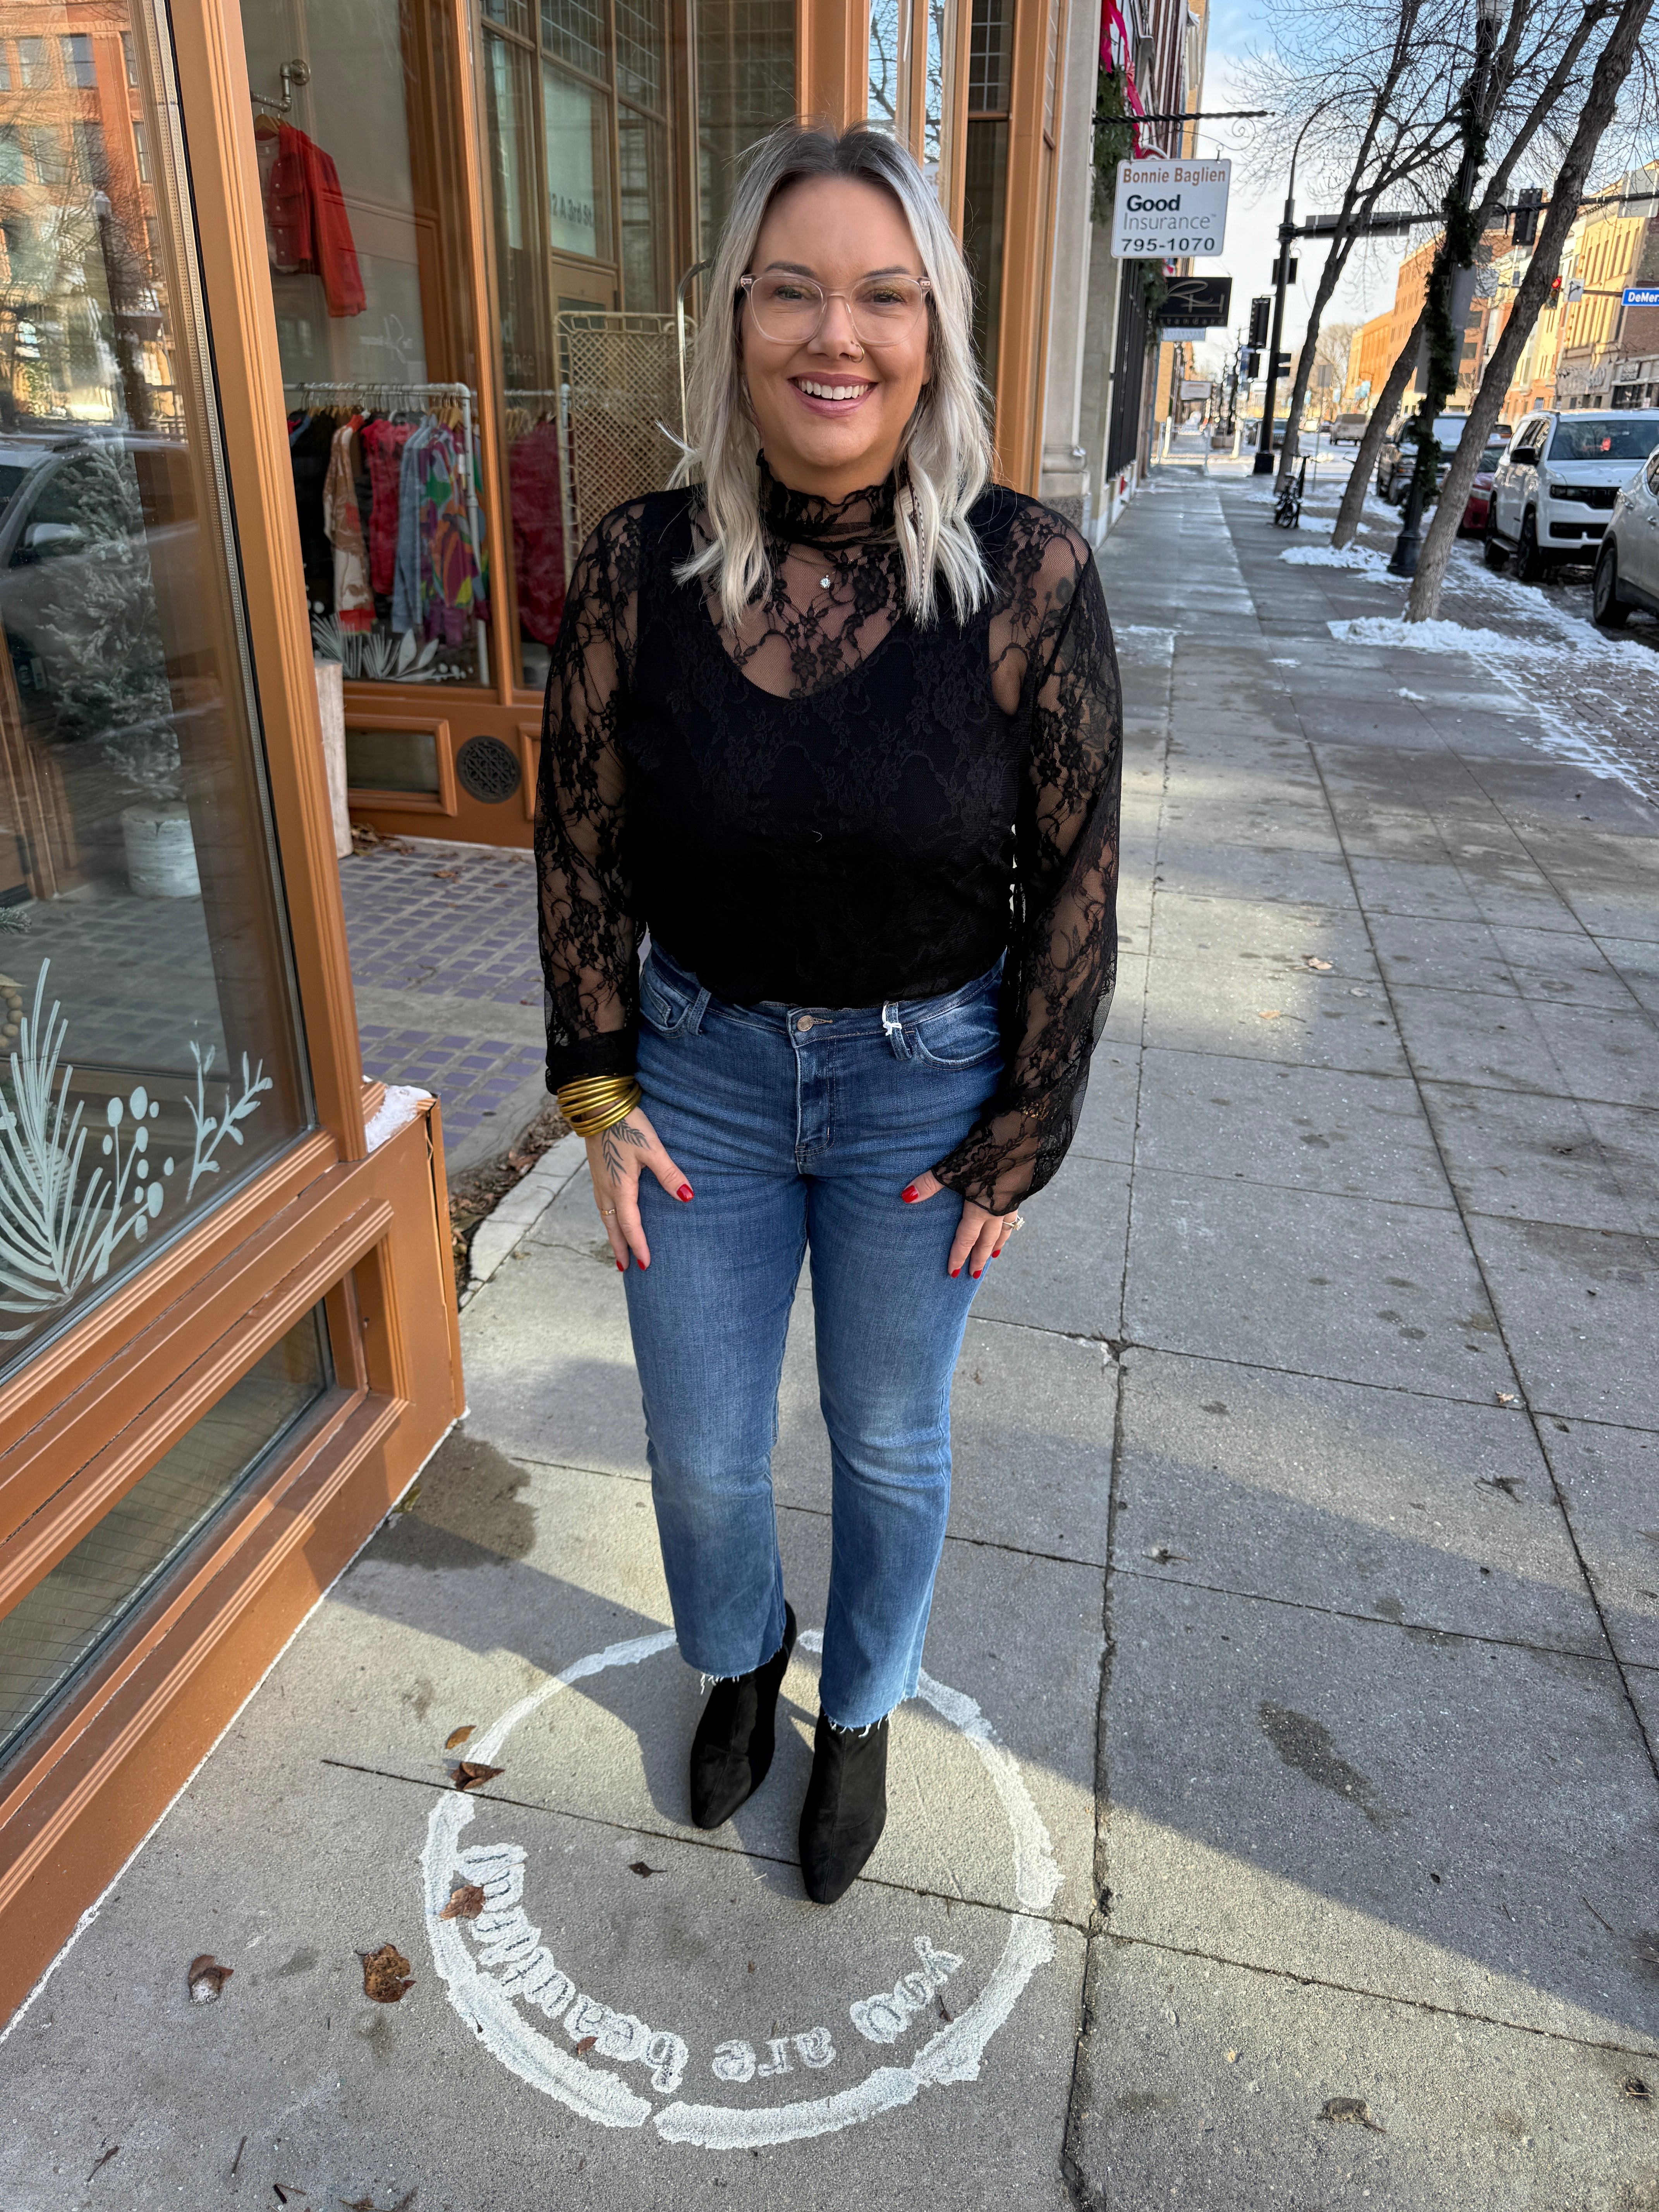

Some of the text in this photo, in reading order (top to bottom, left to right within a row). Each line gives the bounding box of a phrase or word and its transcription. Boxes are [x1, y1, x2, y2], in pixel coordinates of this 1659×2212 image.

[1123, 167, 1226, 186] Bonnie Baglien
[1127, 194, 1181, 212] Good
[1121, 237, 1215, 252] 795-1070
[1628, 292, 1659, 302] DeMer
[454, 1843, 689, 2094] beautiful
[712, 2027, 837, 2083] are
